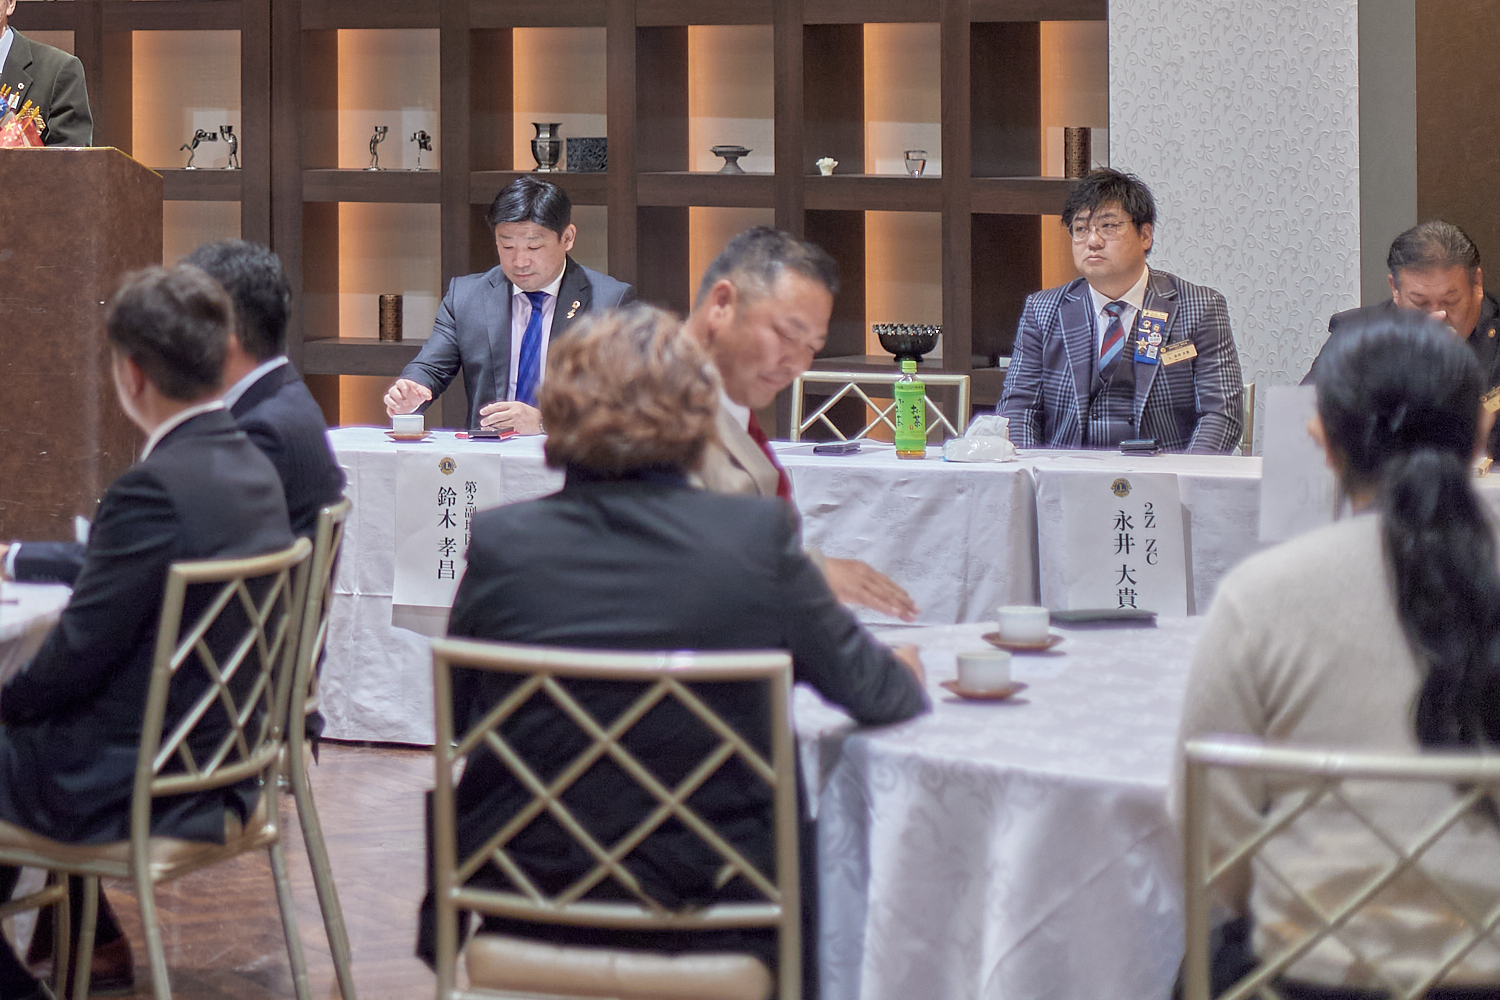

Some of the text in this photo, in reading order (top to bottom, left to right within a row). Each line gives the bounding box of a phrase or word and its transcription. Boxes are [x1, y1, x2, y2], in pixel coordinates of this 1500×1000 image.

[437, 486, 458, 580] 鈴木 孝昌
[1112, 510, 1136, 555] 永井
